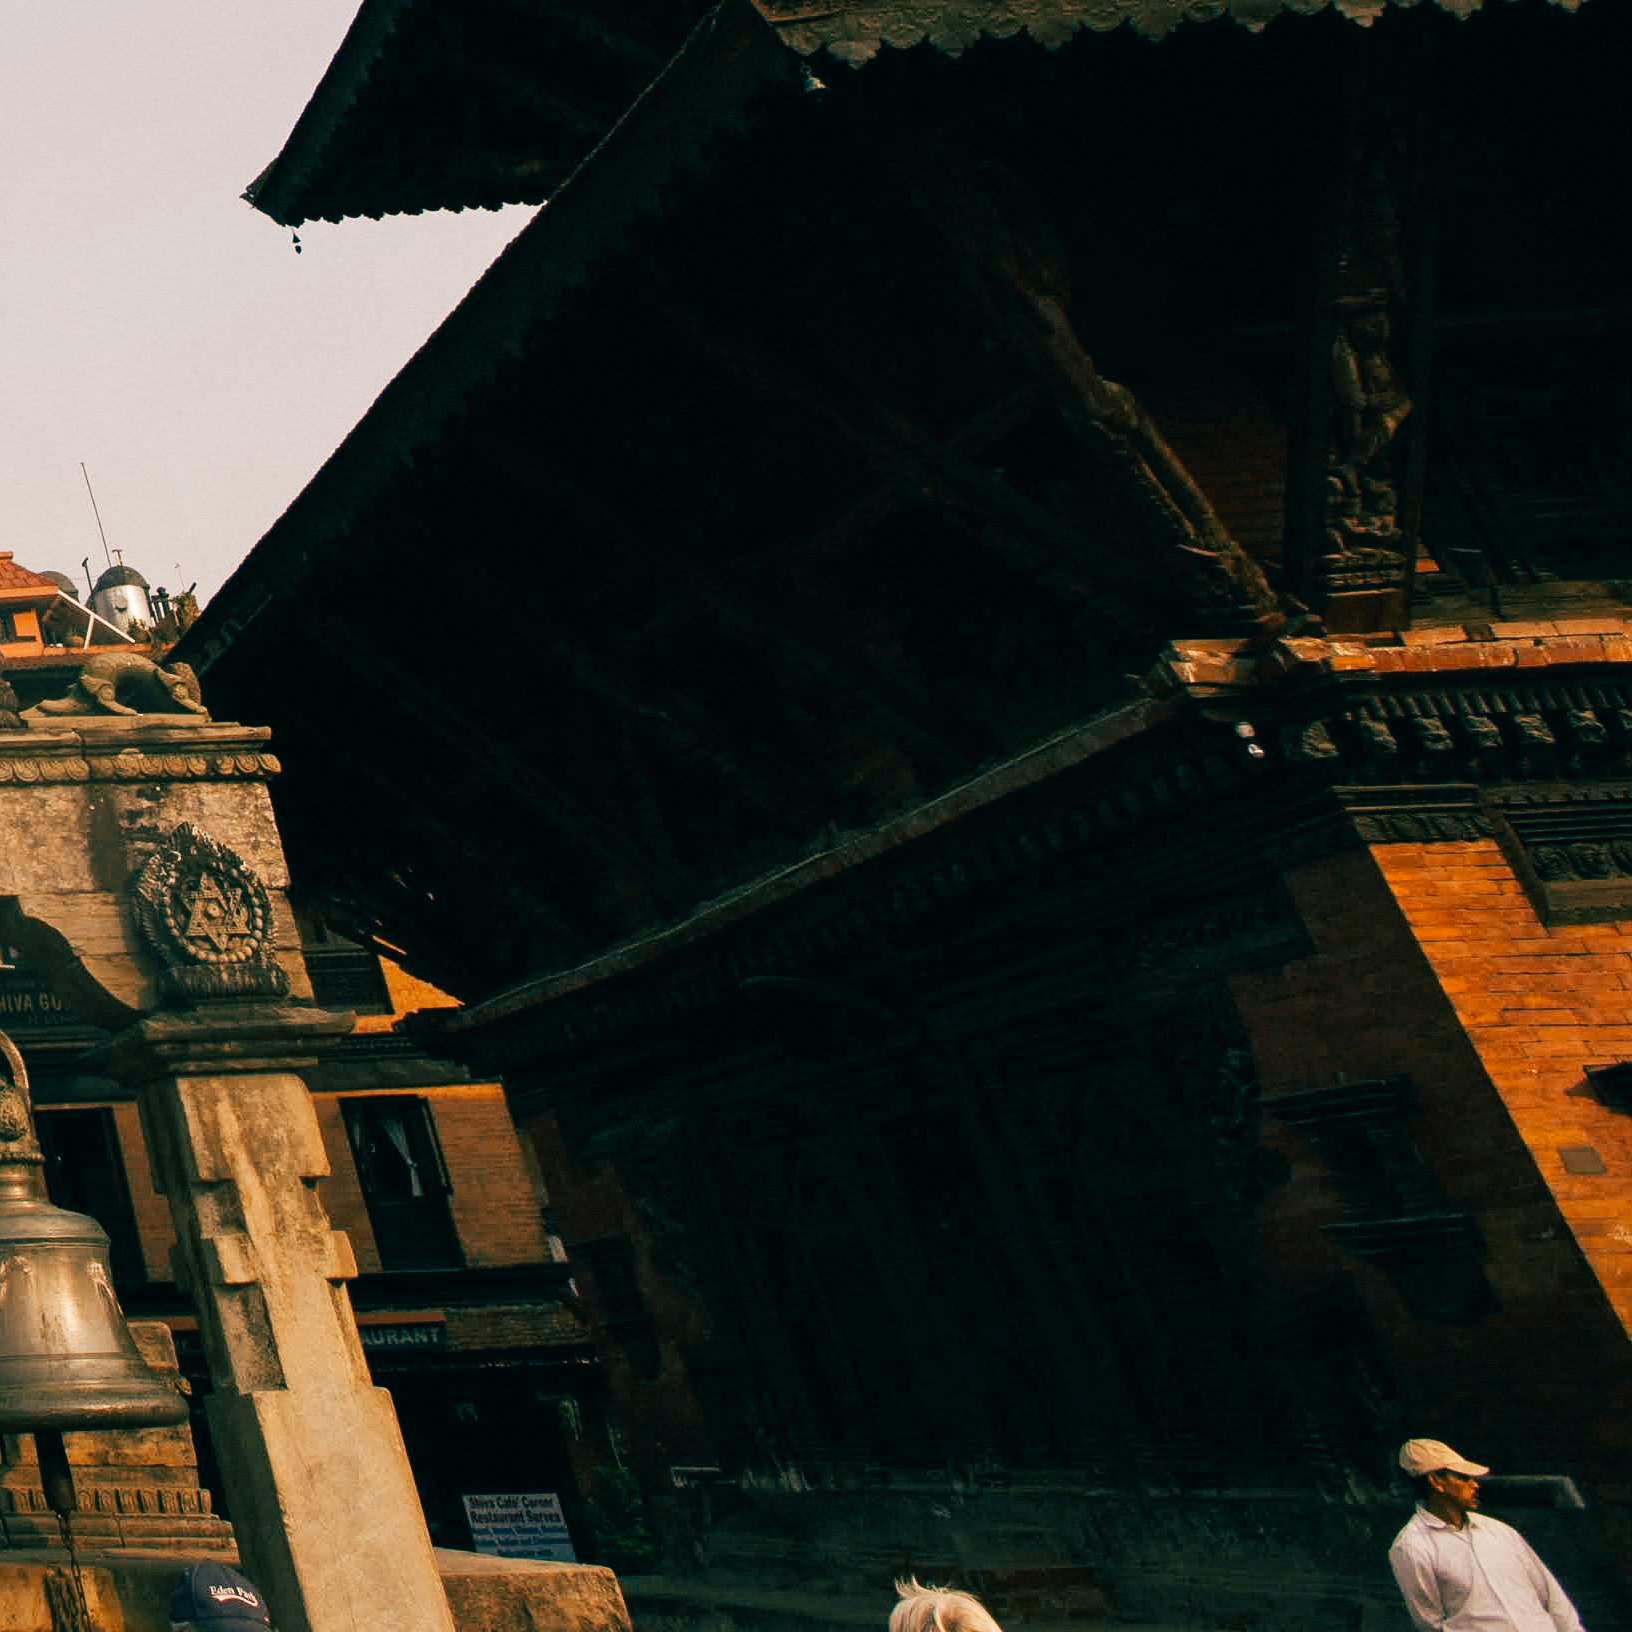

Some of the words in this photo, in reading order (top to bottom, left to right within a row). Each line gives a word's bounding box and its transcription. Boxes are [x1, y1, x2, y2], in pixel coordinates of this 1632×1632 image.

[39, 992, 63, 1010] GU
[470, 1510, 525, 1523] Restaurant
[209, 1585, 235, 1596] Eden
